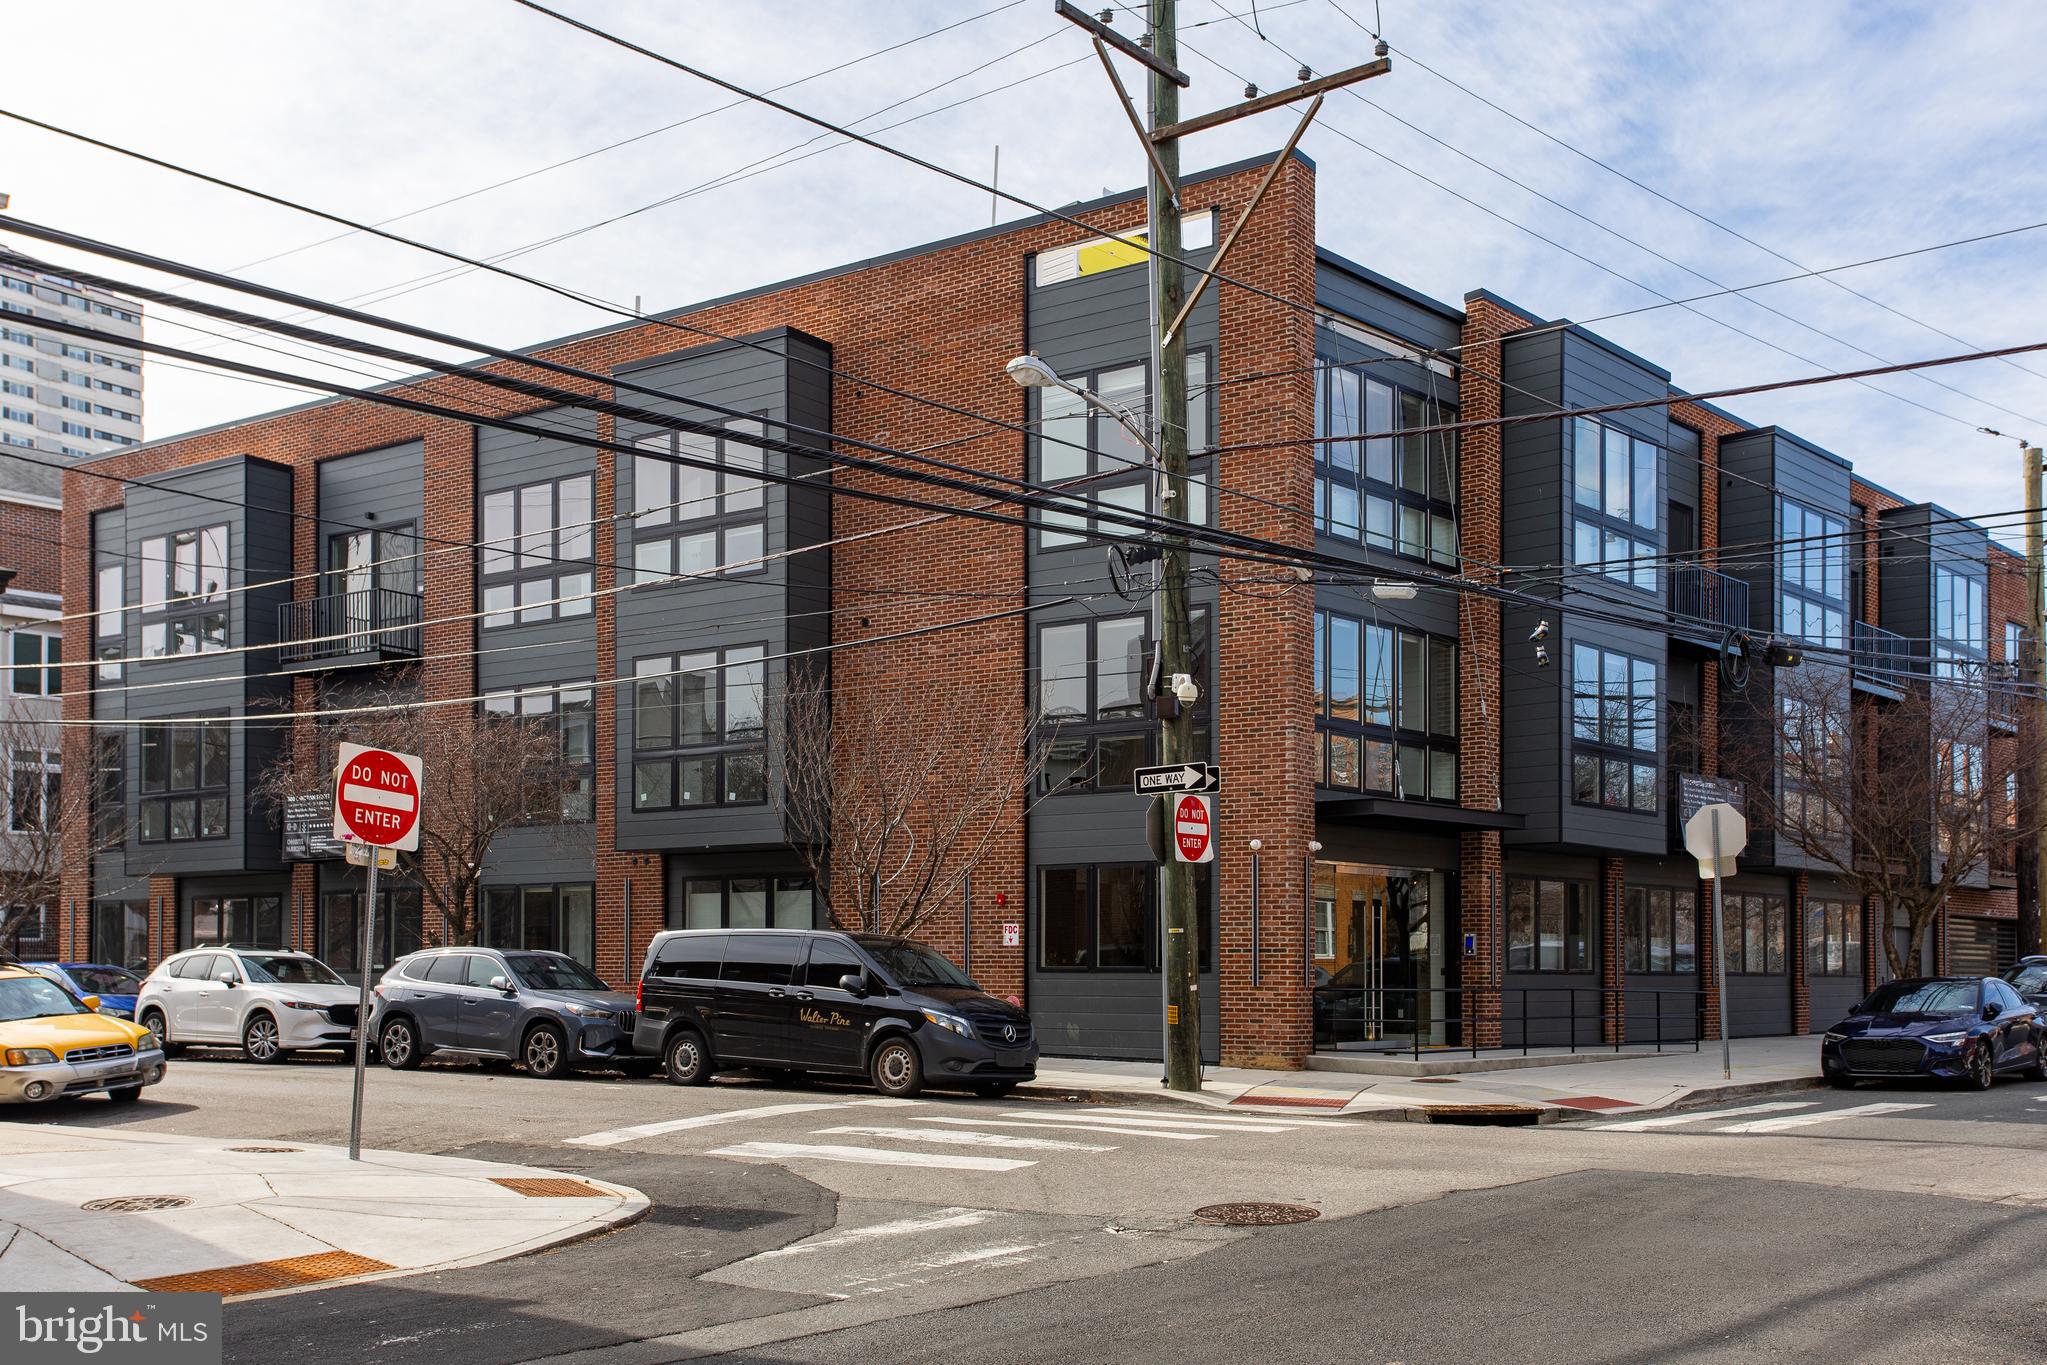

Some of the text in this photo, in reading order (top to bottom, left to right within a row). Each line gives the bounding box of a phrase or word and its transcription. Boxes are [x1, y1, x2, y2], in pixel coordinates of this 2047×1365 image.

[352, 765, 409, 789] DO NOT
[1142, 772, 1185, 787] ONE WAY
[355, 808, 401, 830] ENTER
[1180, 807, 1205, 820] DO NOT
[1182, 837, 1202, 849] ENTER
[1004, 925, 1018, 934] FDC
[800, 1007, 851, 1026] Walter Pine
